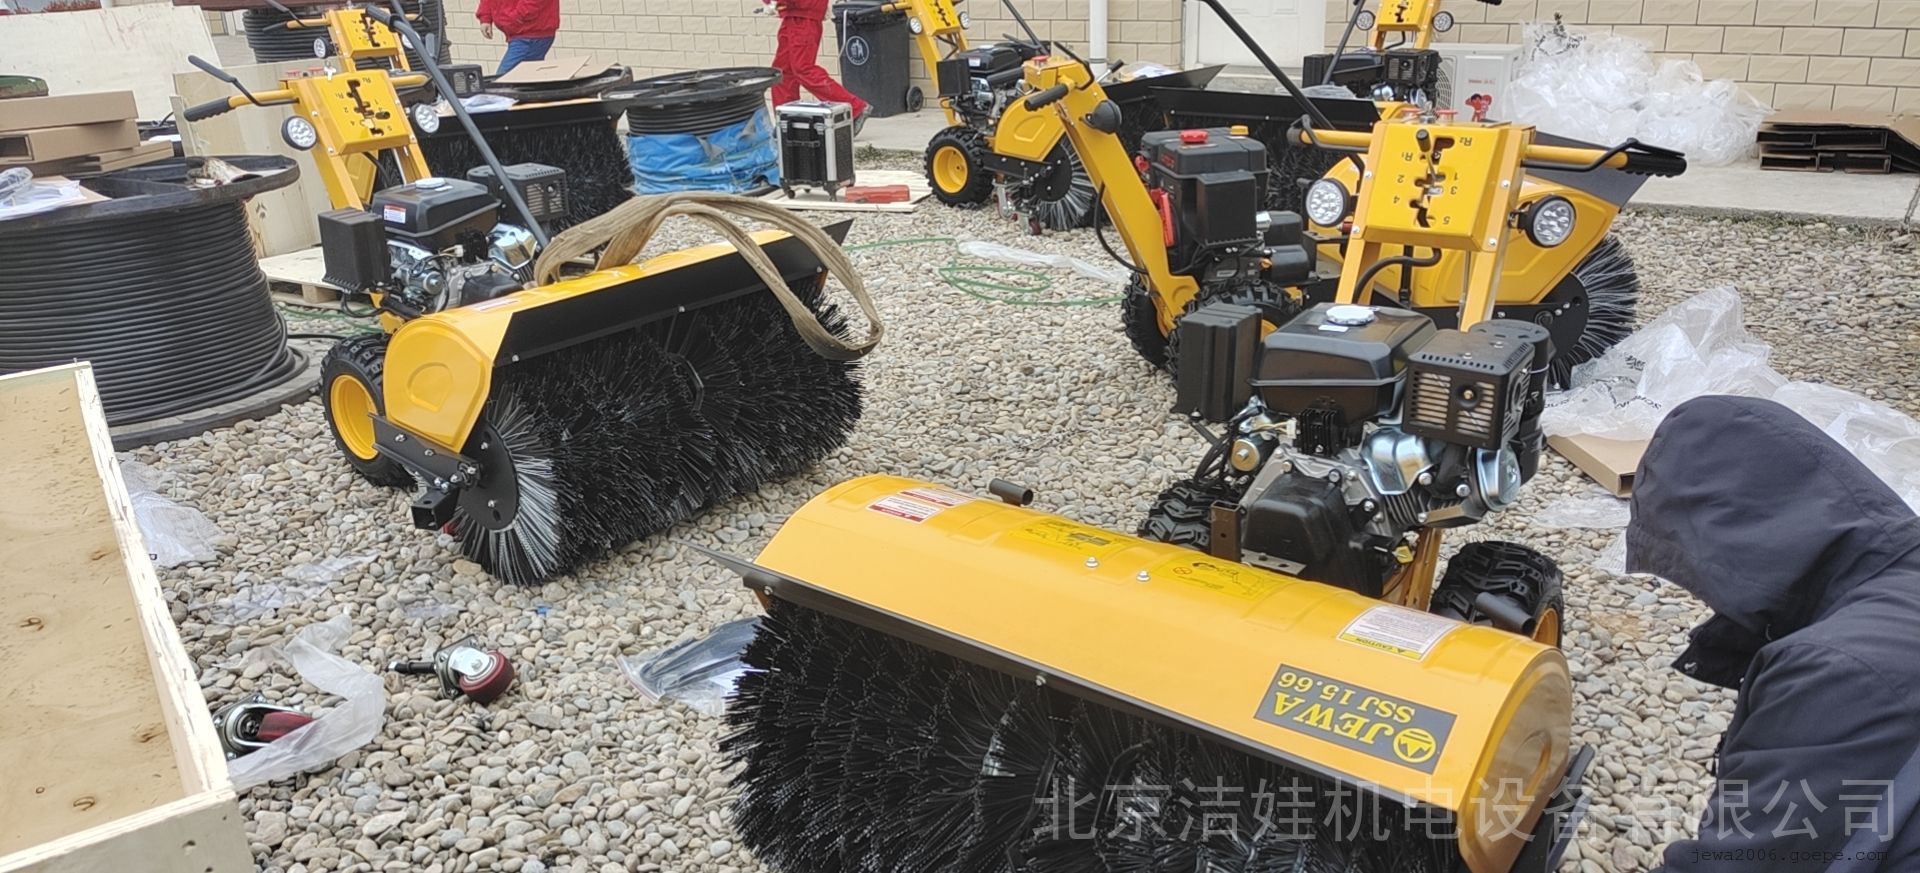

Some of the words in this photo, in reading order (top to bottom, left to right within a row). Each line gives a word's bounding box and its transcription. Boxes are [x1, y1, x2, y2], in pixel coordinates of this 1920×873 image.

[1397, 174, 1405, 184] 2
[1450, 186, 1458, 195] 3
[1393, 195, 1401, 204] 4
[1442, 215, 1451, 225] 5
[1277, 671, 1356, 706] 15.66
[1357, 695, 1416, 724] SSJ
[1272, 691, 1395, 745] JEWA
